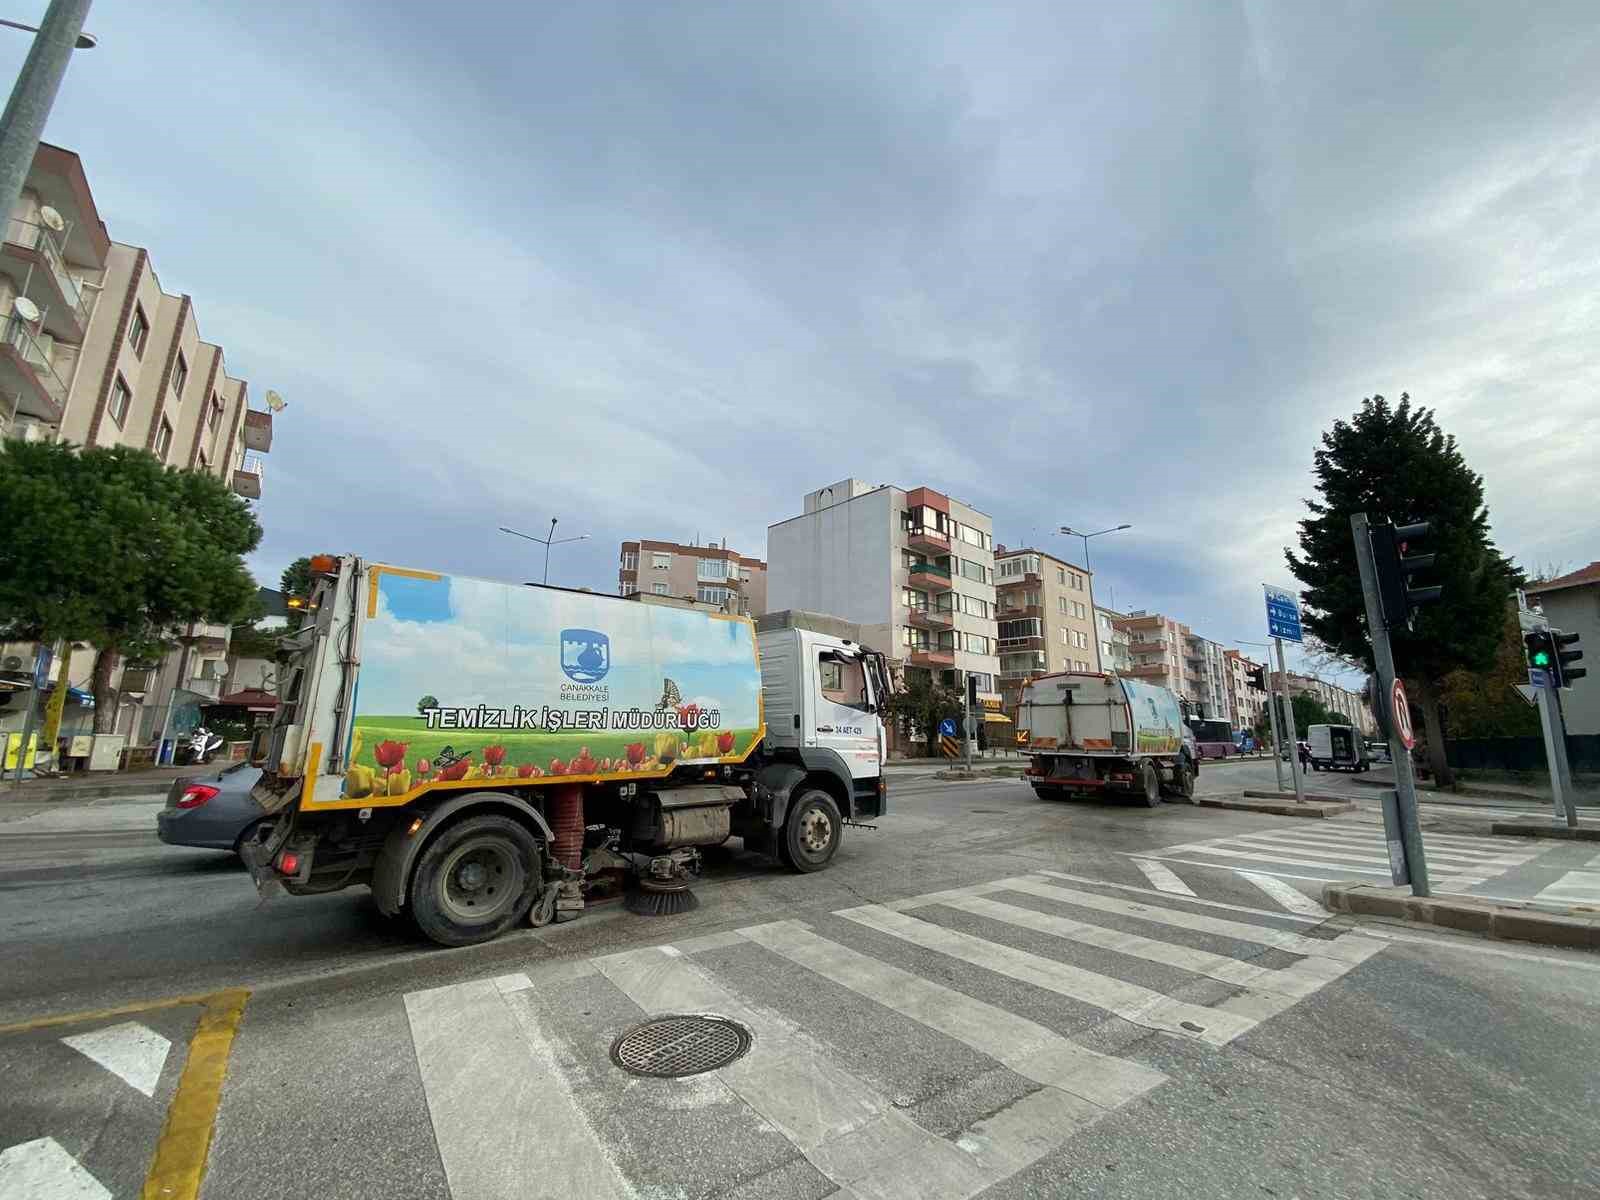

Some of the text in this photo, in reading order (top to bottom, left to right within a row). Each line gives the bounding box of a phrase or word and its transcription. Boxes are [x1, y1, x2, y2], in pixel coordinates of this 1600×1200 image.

[423, 704, 720, 733] TEMİZLİK İŞLERİ MÜDÜRLÜĞÜ
